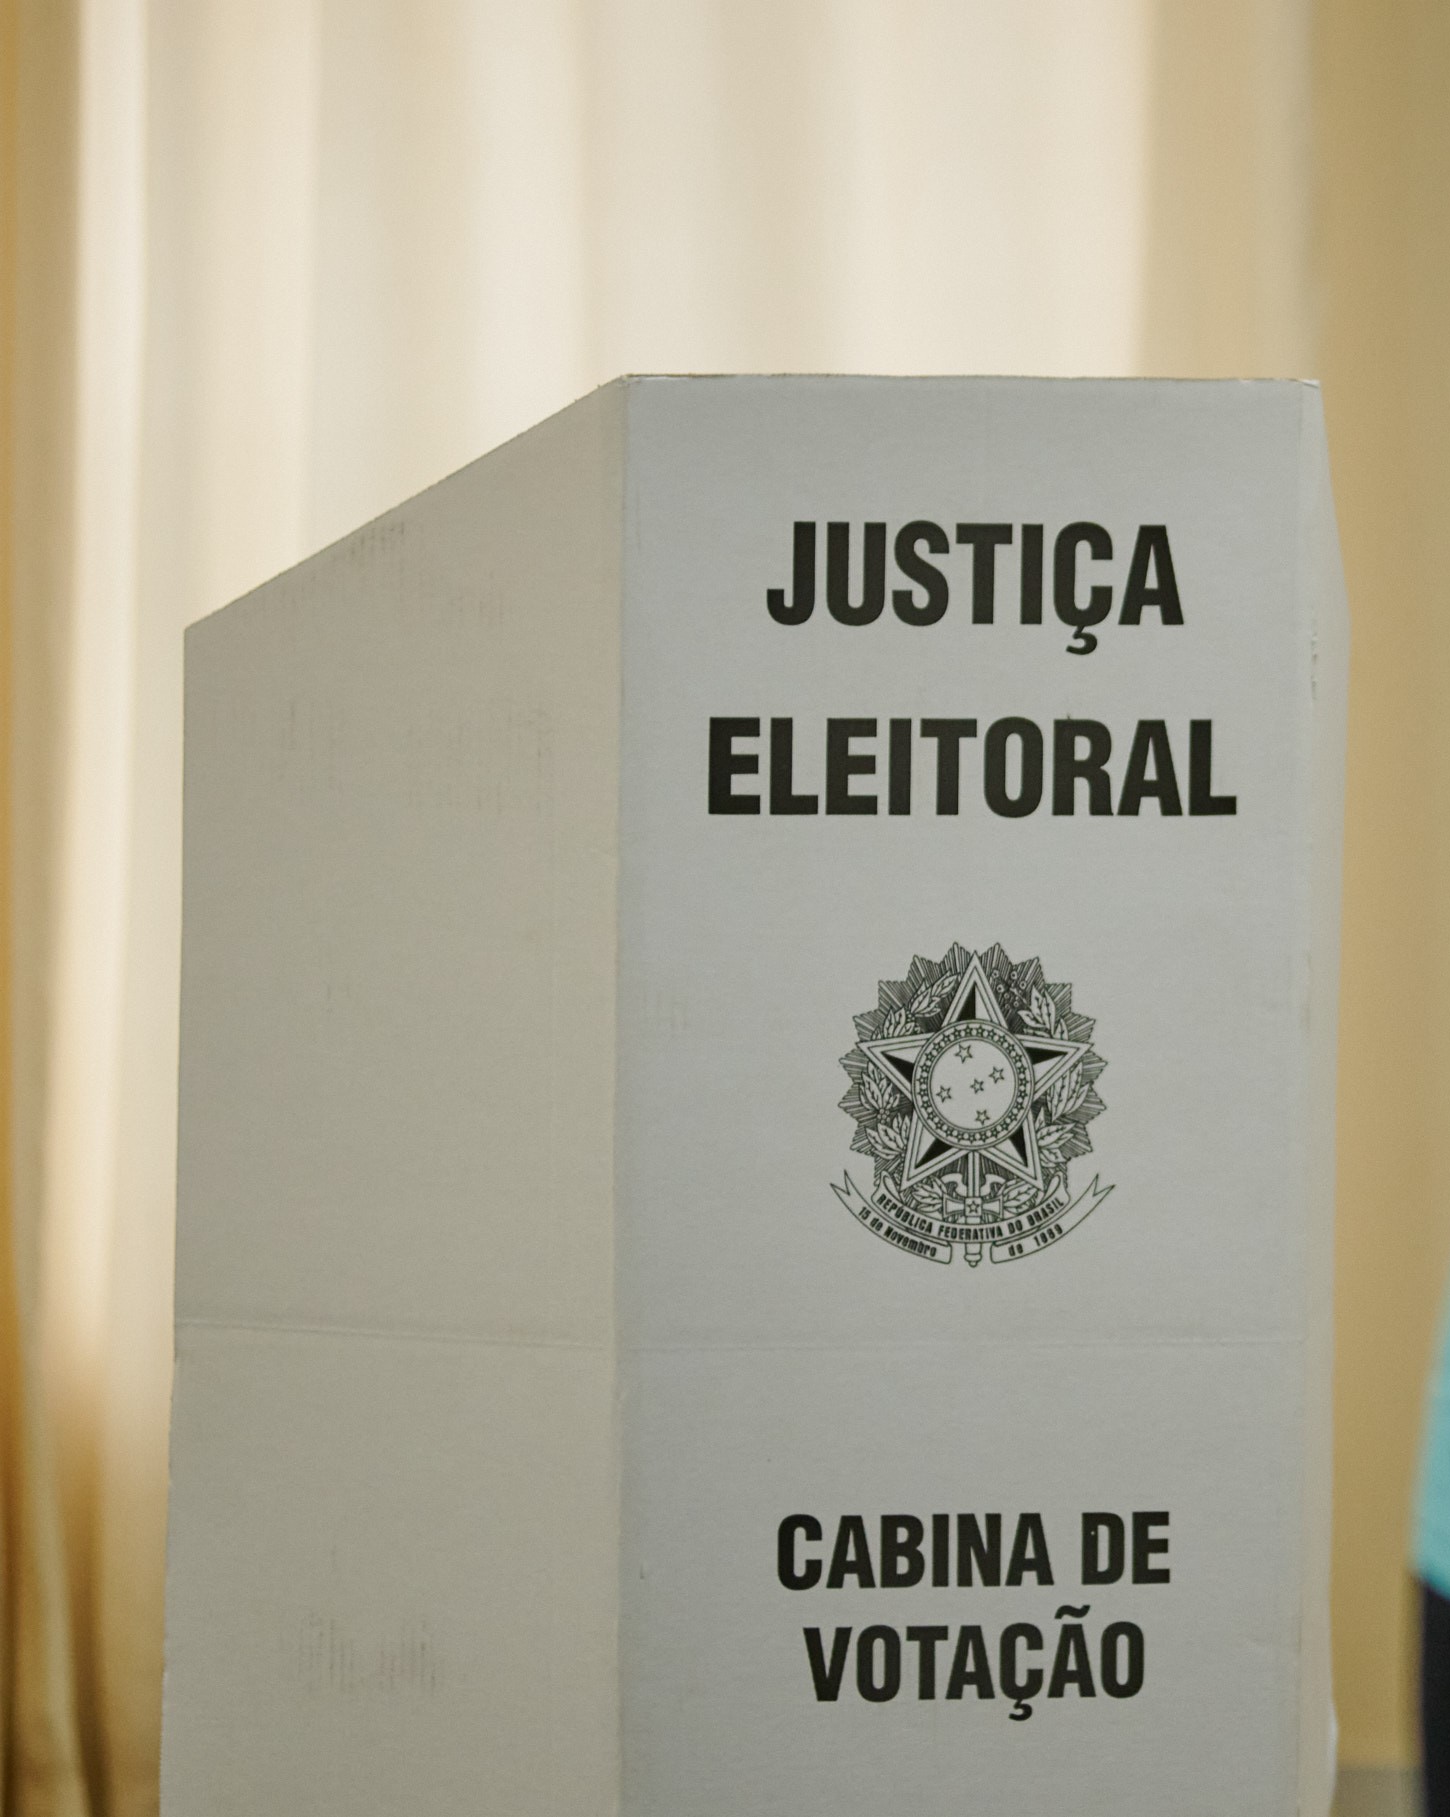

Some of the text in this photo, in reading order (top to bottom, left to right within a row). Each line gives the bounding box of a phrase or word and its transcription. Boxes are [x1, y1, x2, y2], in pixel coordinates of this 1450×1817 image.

[766, 520, 1185, 656] JUSTIÇA
[707, 716, 1237, 819] ELEITORAL
[858, 1206, 870, 1221] 15
[869, 1217, 883, 1231] de
[884, 1227, 937, 1257] Novembro
[1008, 1243, 1023, 1257] de
[877, 1193, 1064, 1241] REPÚBLICA FEDERATIVA DO BRASIL
[777, 1510, 1171, 1591] CABINA DE
[802, 1603, 1145, 1722] VOTAÇÃO
